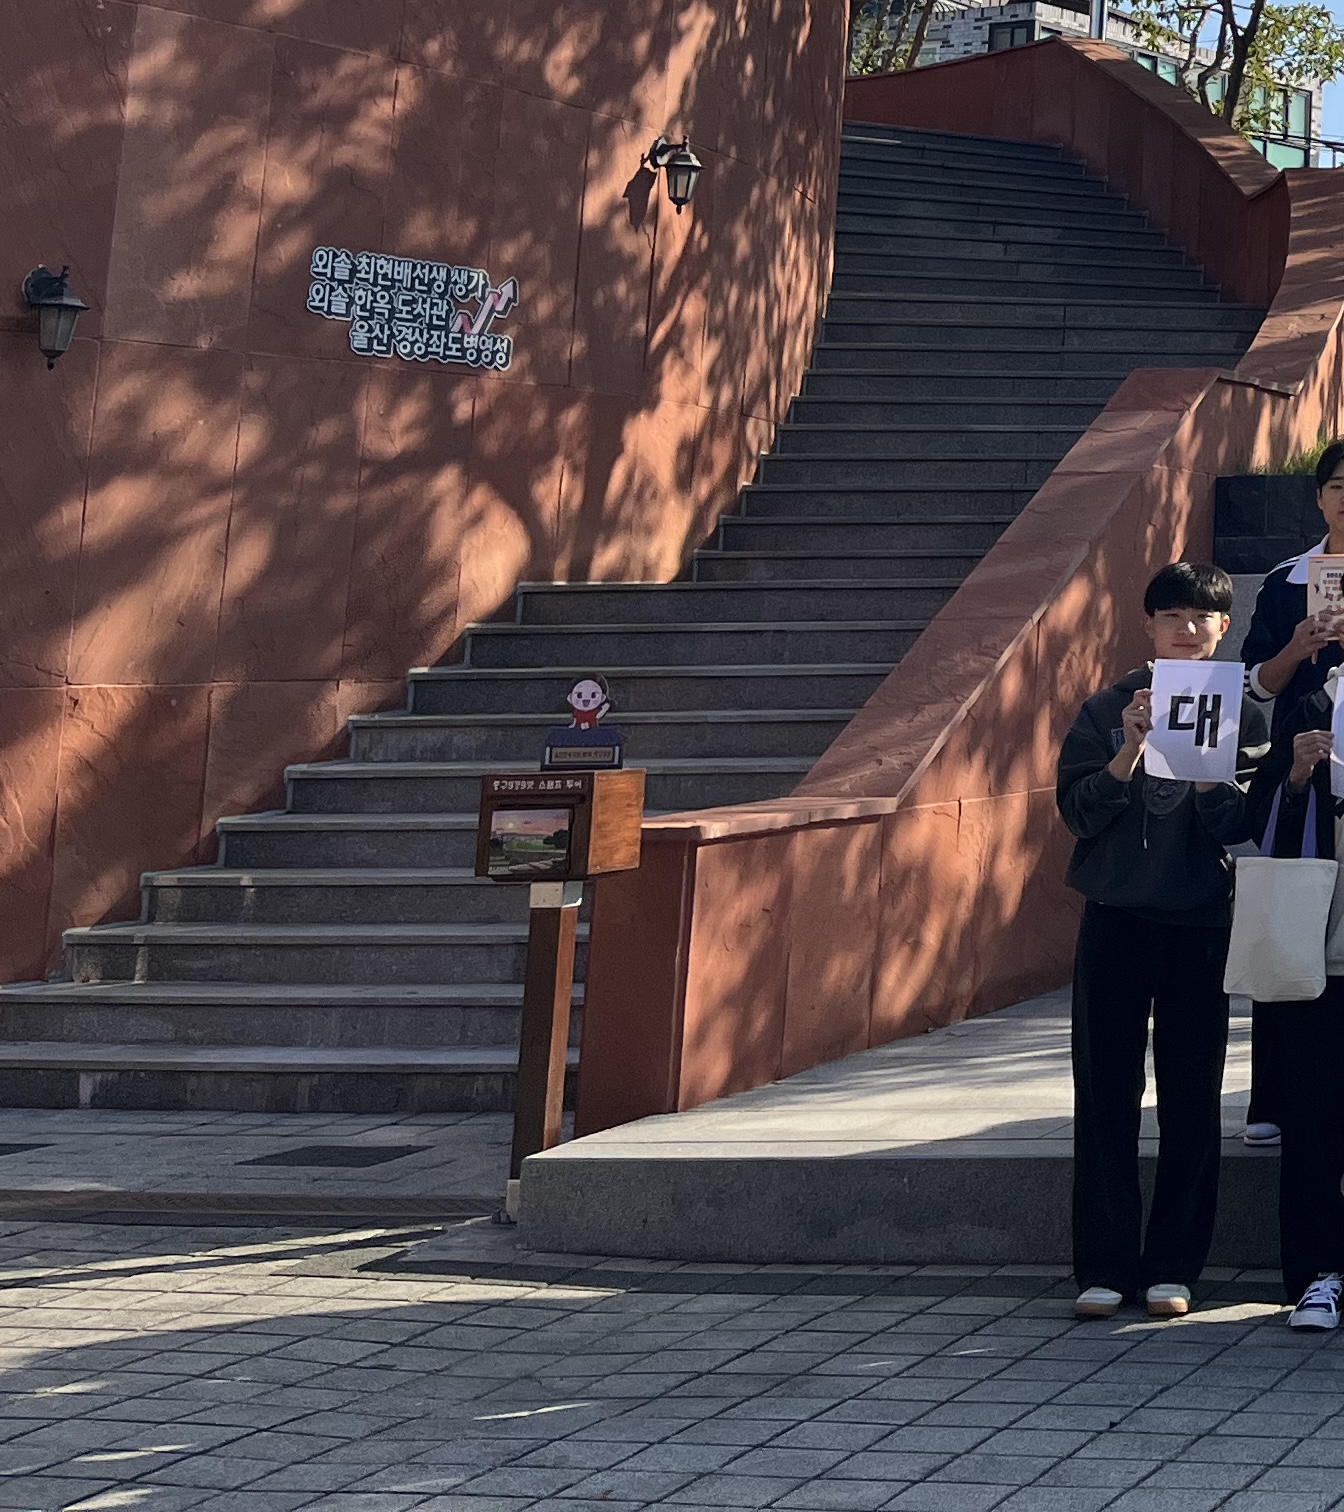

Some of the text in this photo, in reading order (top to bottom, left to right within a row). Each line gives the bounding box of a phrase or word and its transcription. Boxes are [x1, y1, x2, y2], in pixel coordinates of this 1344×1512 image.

[313, 250, 352, 279] 외솔
[451, 270, 485, 297] 생가
[309, 284, 449, 326] 외솔 한옥 도서관
[352, 321, 390, 350] 울산
[1168, 694, 1221, 748] 대
